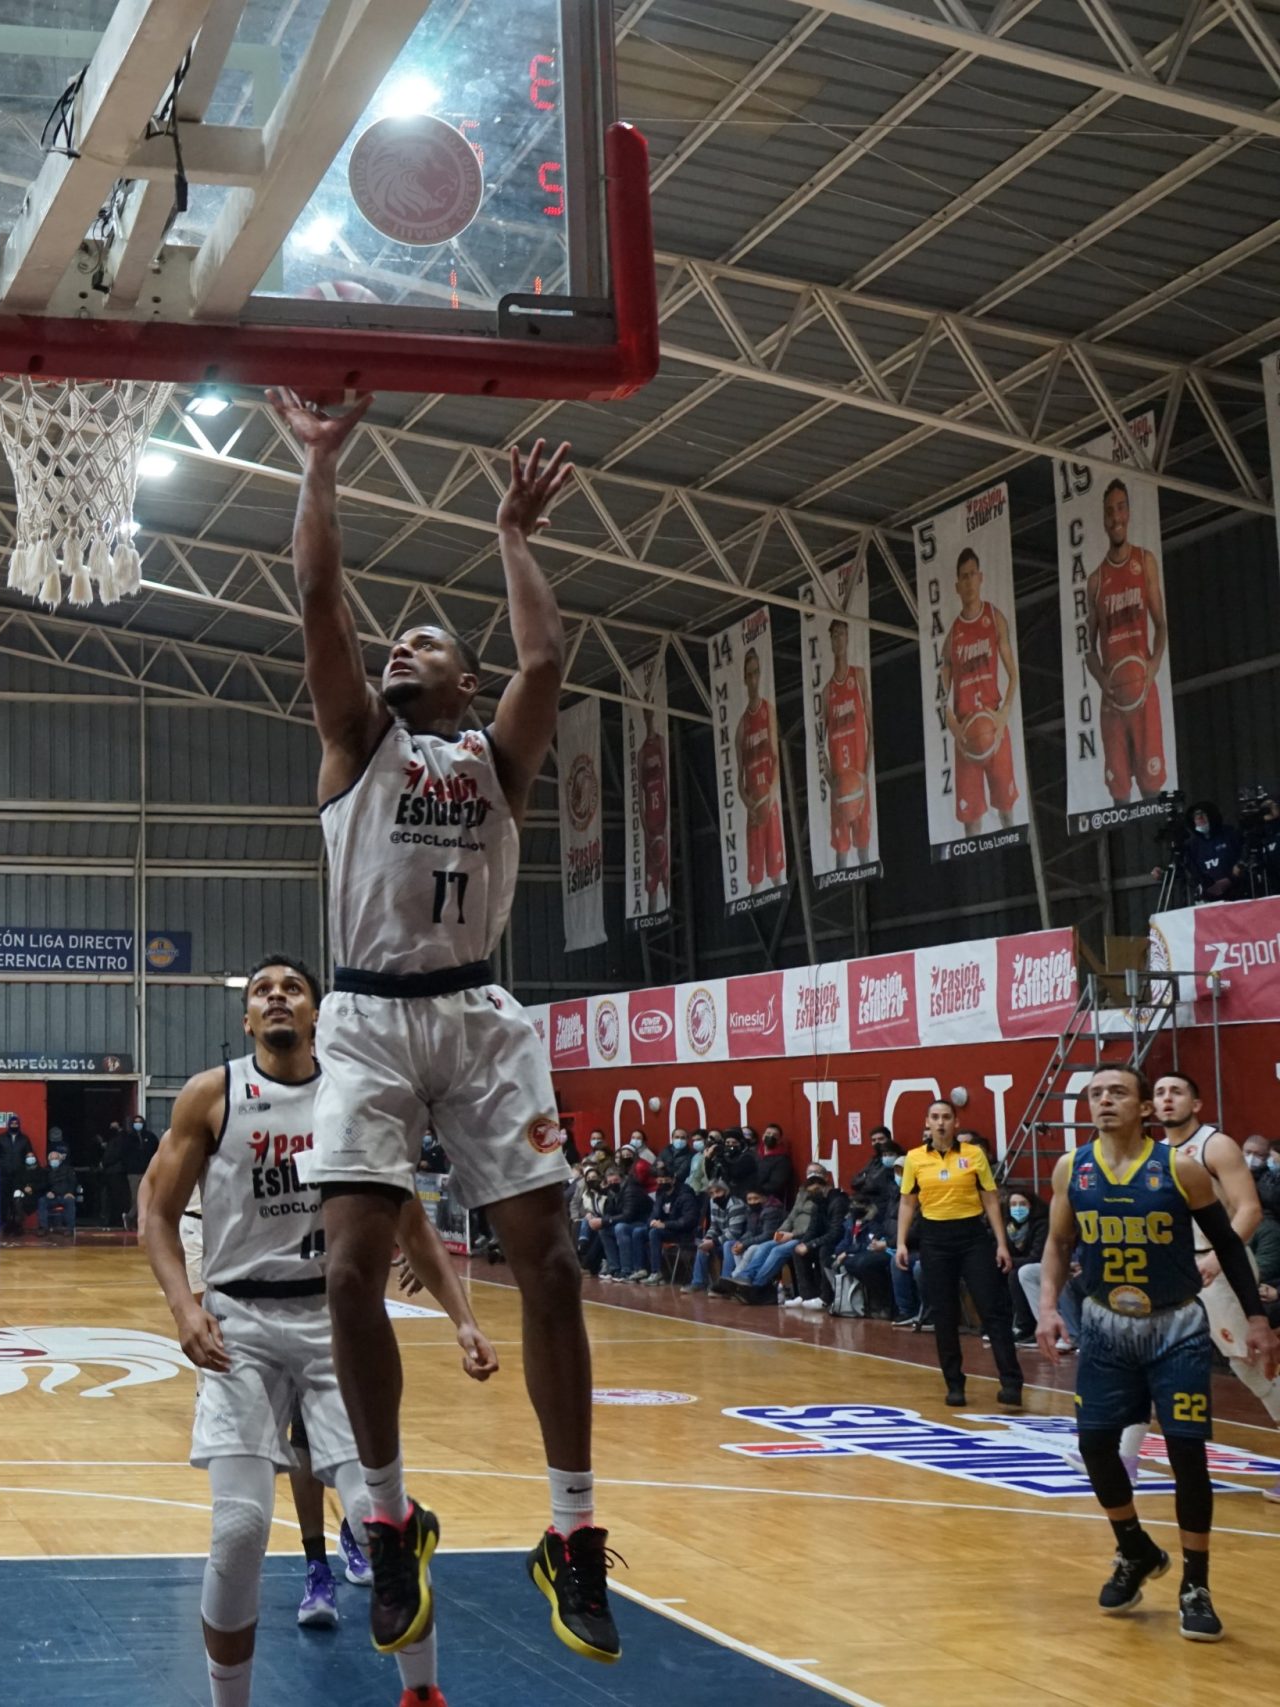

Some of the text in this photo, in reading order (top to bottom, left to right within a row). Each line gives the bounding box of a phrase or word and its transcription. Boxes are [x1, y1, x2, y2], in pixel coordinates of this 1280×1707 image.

[917, 521, 936, 565] 5
[713, 632, 733, 670] 14
[928, 578, 952, 796] GALAVIZ
[953, 840, 977, 856] CDC
[30, 934, 64, 948] LIGA
[69, 936, 133, 950] DIRECTV
[66, 955, 128, 970] CENTRO
[940, 961, 980, 992] Pasión
[1024, 946, 1071, 984] Pasión
[869, 971, 903, 1001] Pasión
[930, 985, 980, 1017] Esfuerzo
[1011, 970, 1071, 1010] Esfuerzo
[858, 995, 904, 1025] Esfuerzo
[62, 1059, 96, 1070] 2016
[1102, 1247, 1149, 1284] 22
[1173, 1392, 1207, 1422] 22
